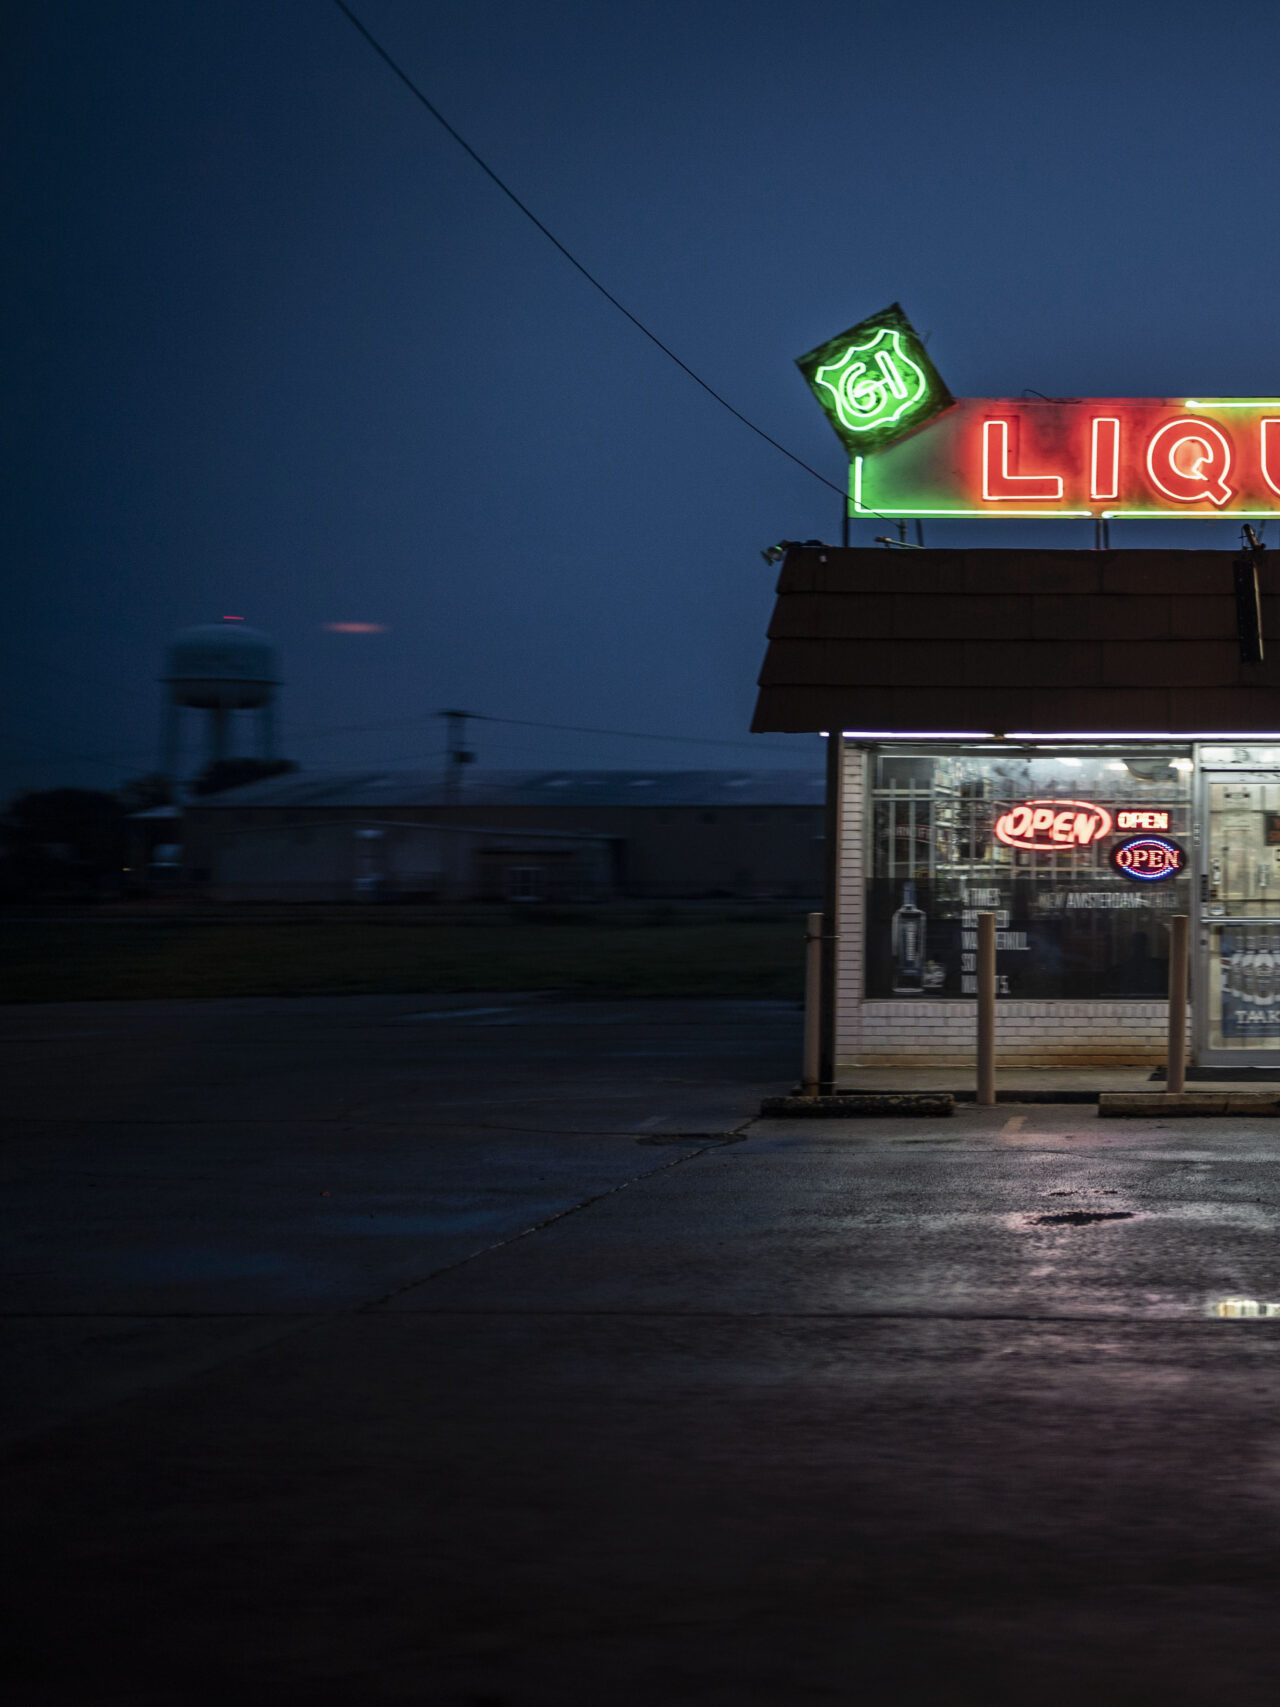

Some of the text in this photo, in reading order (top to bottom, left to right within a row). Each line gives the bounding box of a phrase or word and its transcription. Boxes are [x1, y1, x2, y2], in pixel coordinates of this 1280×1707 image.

[1004, 806, 1100, 845] OPEN
[1118, 812, 1168, 829] OPEN
[1115, 849, 1180, 868] OPEN
